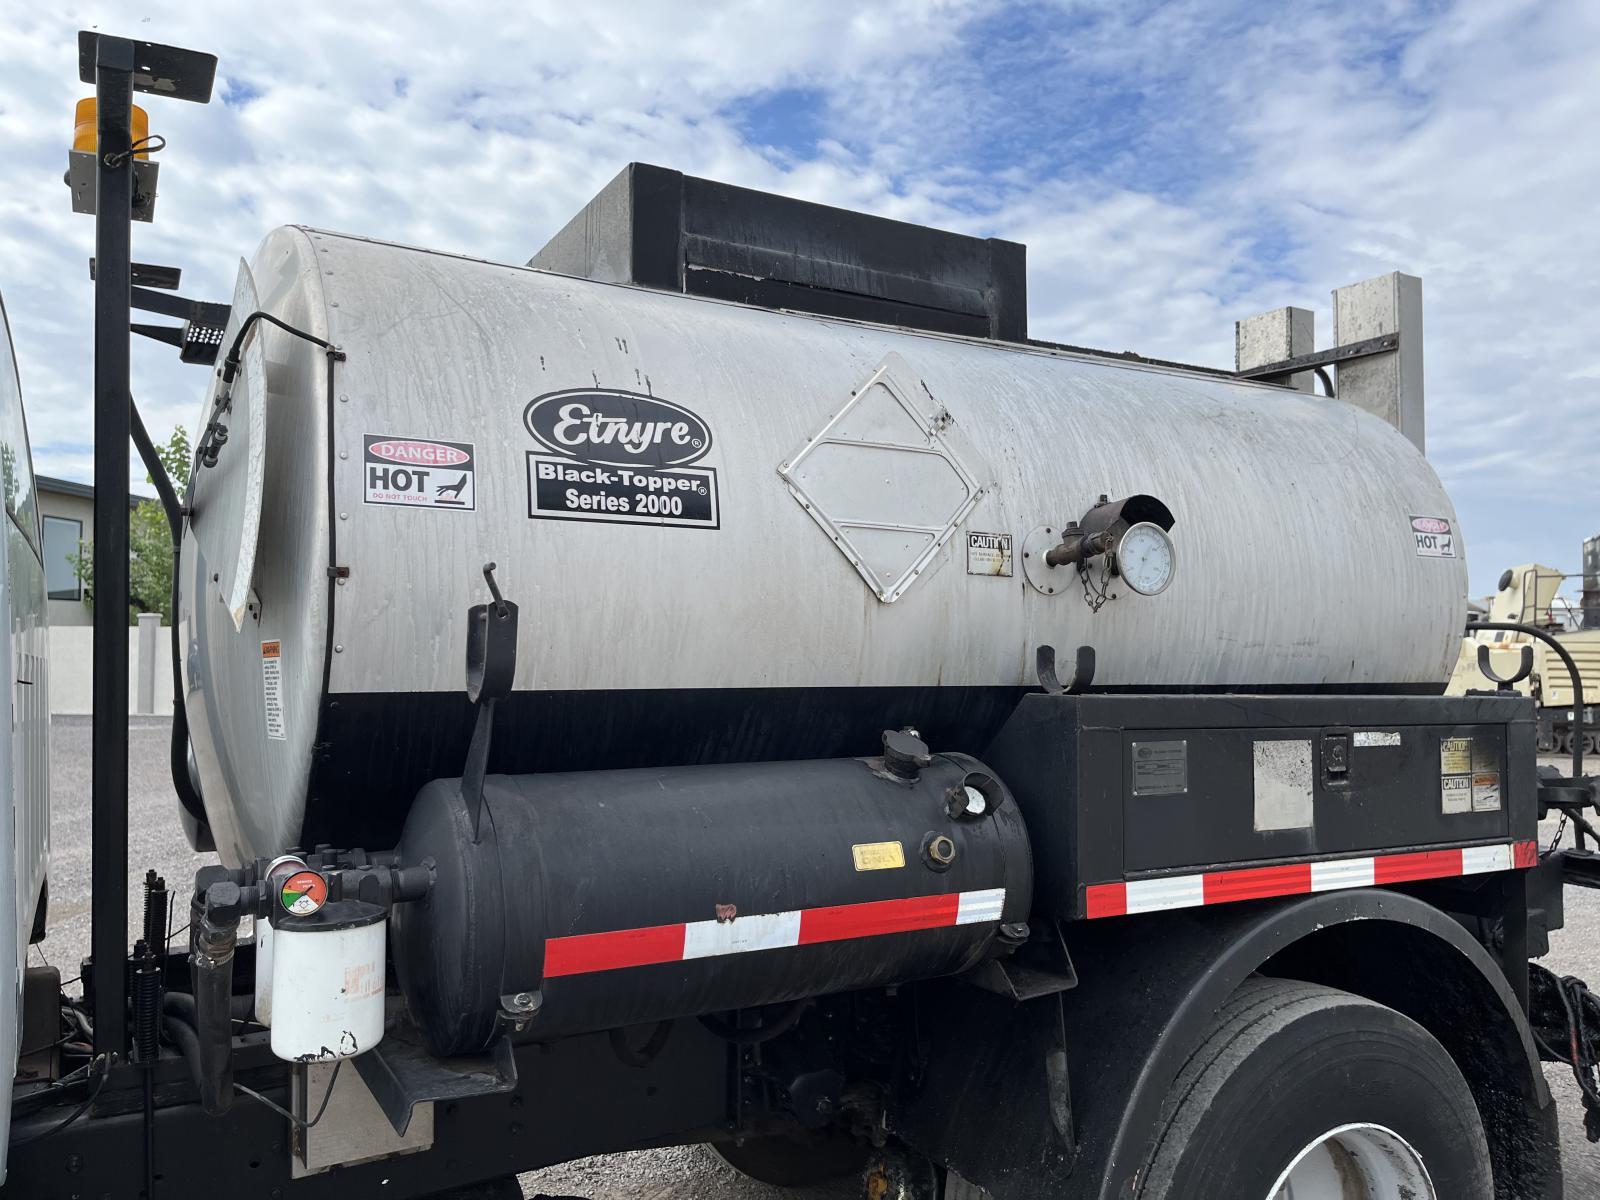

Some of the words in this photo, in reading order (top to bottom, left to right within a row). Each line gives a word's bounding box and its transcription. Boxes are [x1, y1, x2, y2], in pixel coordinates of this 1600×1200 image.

[381, 444, 457, 462] DANGER
[370, 467, 430, 493] HOT
[403, 494, 428, 502] TOUCH
[565, 488, 630, 512] Series
[635, 493, 683, 516] 2000
[1415, 534, 1438, 549] HOT
[1441, 740, 1468, 752] CAUTION
[1443, 778, 1469, 790] CAUTION
